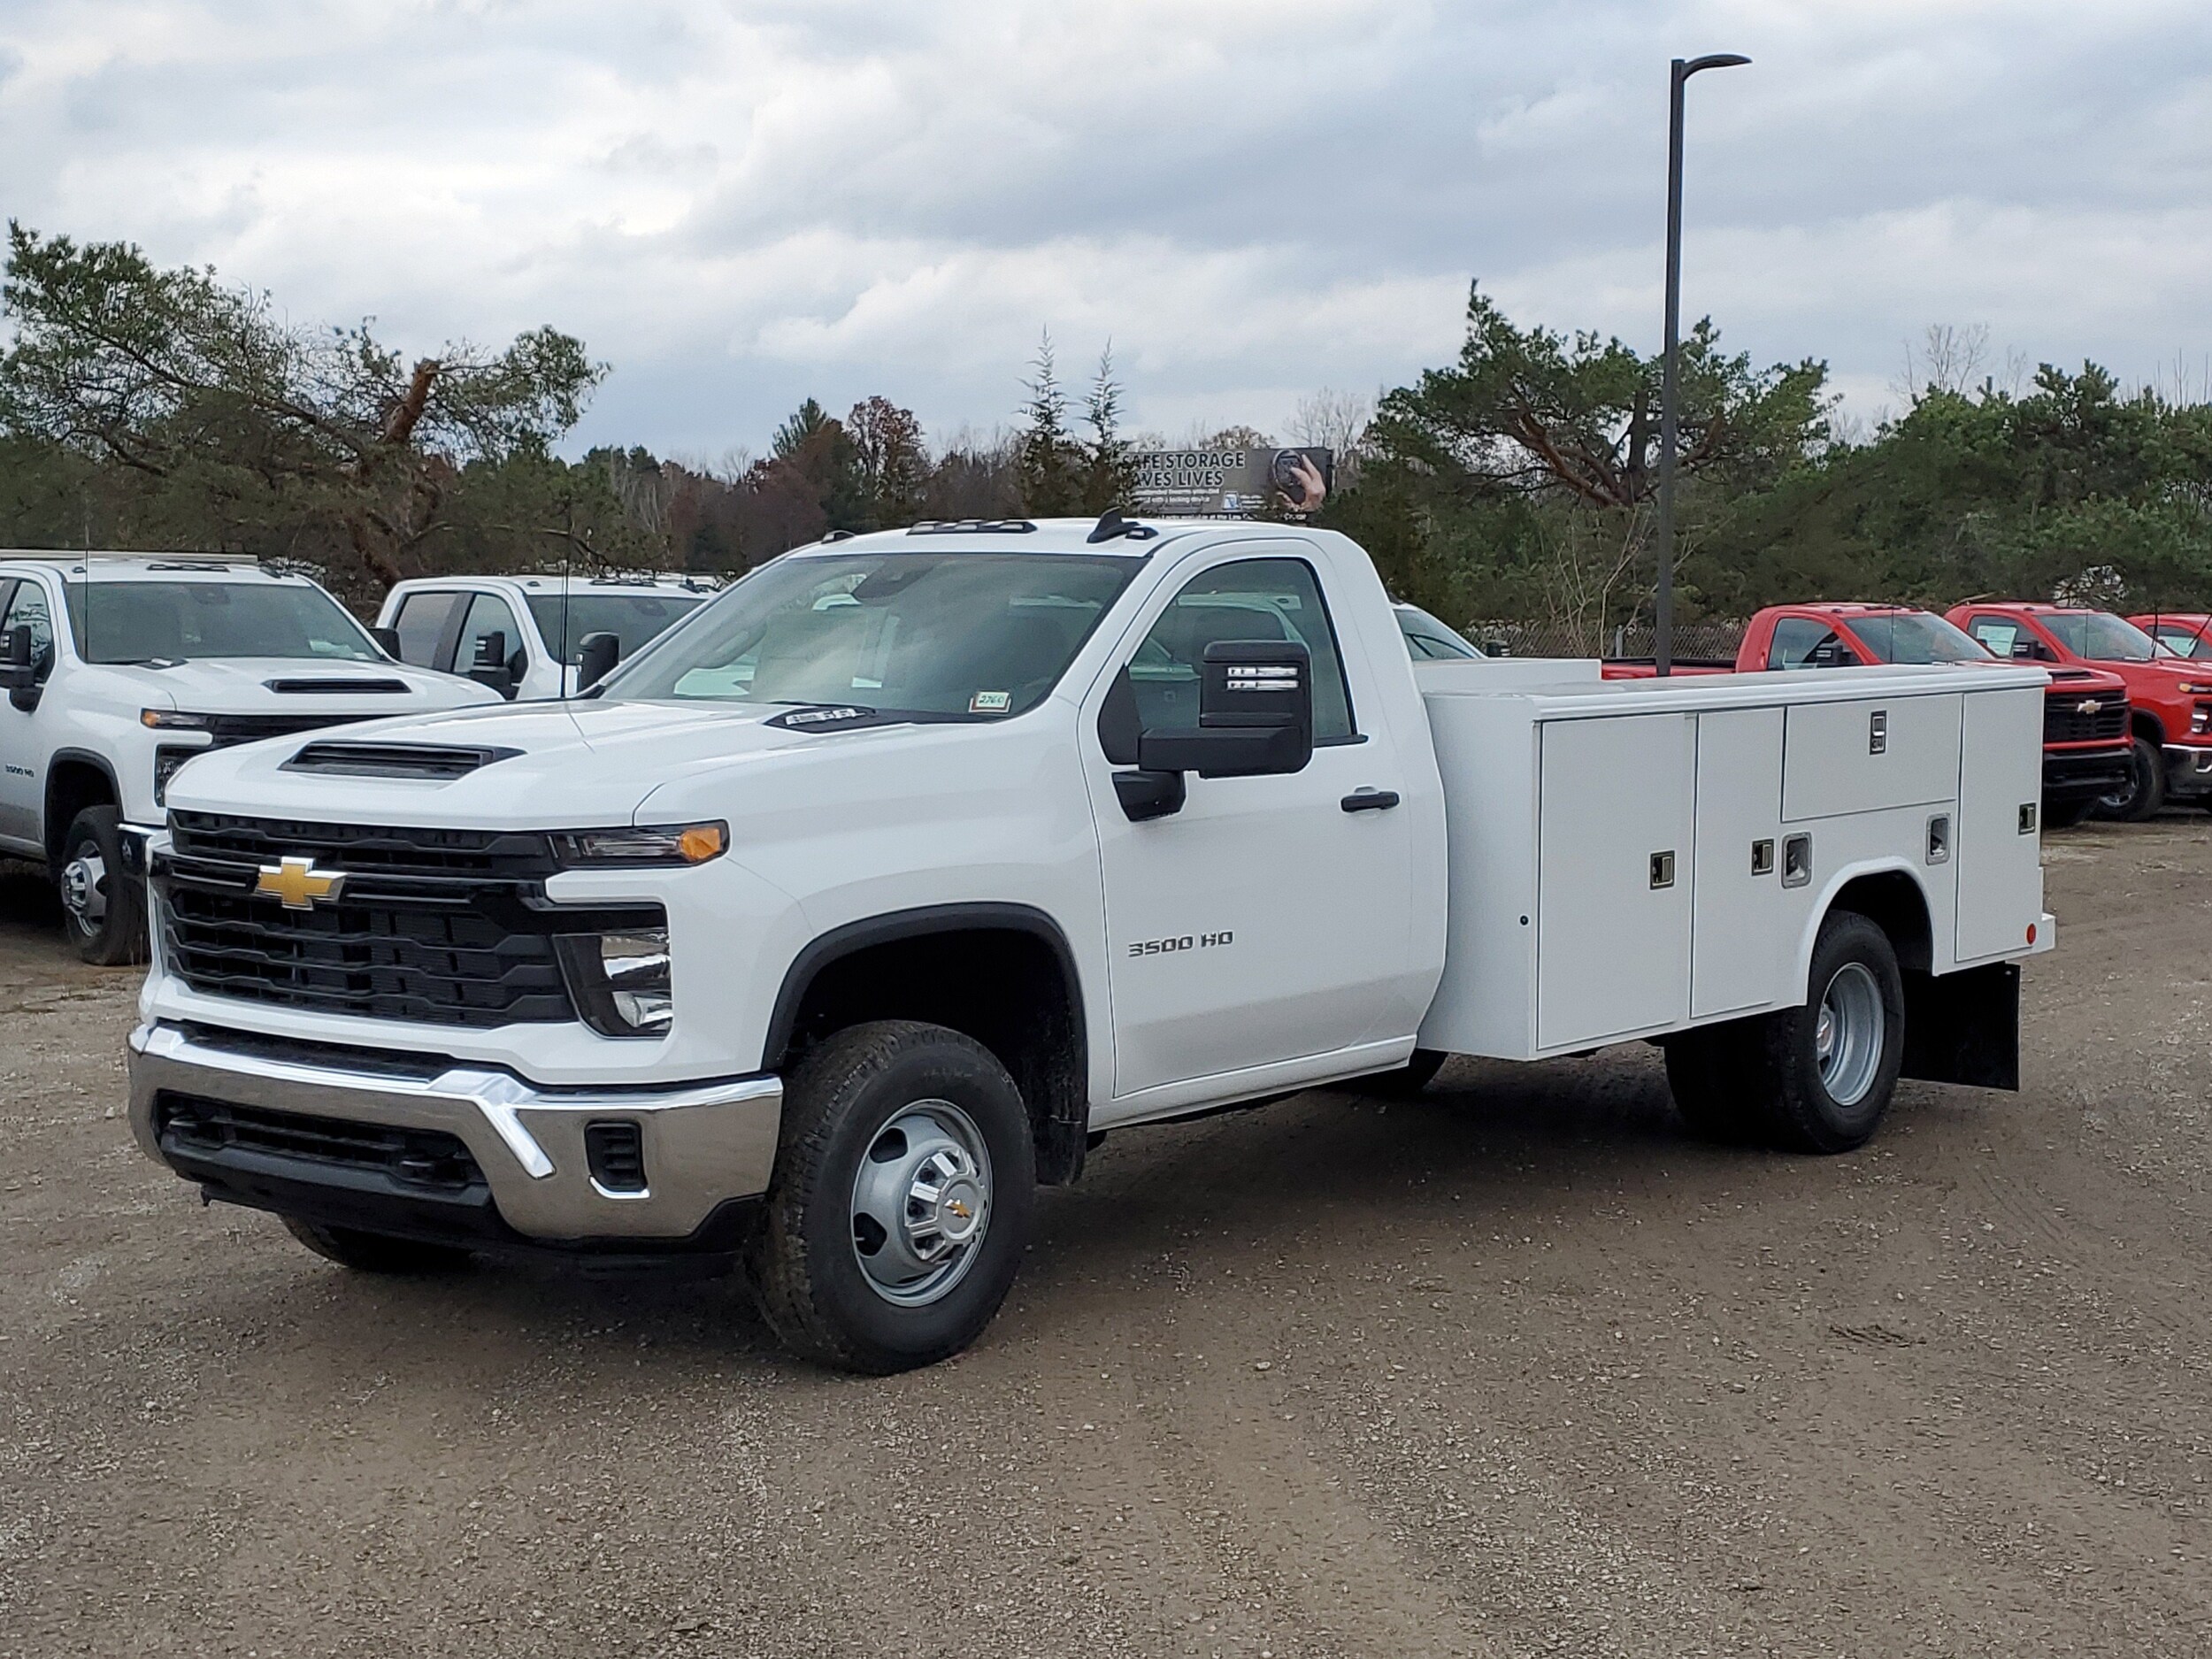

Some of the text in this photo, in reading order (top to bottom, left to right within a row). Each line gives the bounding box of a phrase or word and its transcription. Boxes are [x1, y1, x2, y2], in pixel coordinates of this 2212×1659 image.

[1165, 451, 1245, 469] STORAGE
[1133, 470, 1225, 487] AVES LIVES
[1128, 931, 1233, 957] 3500 HD
